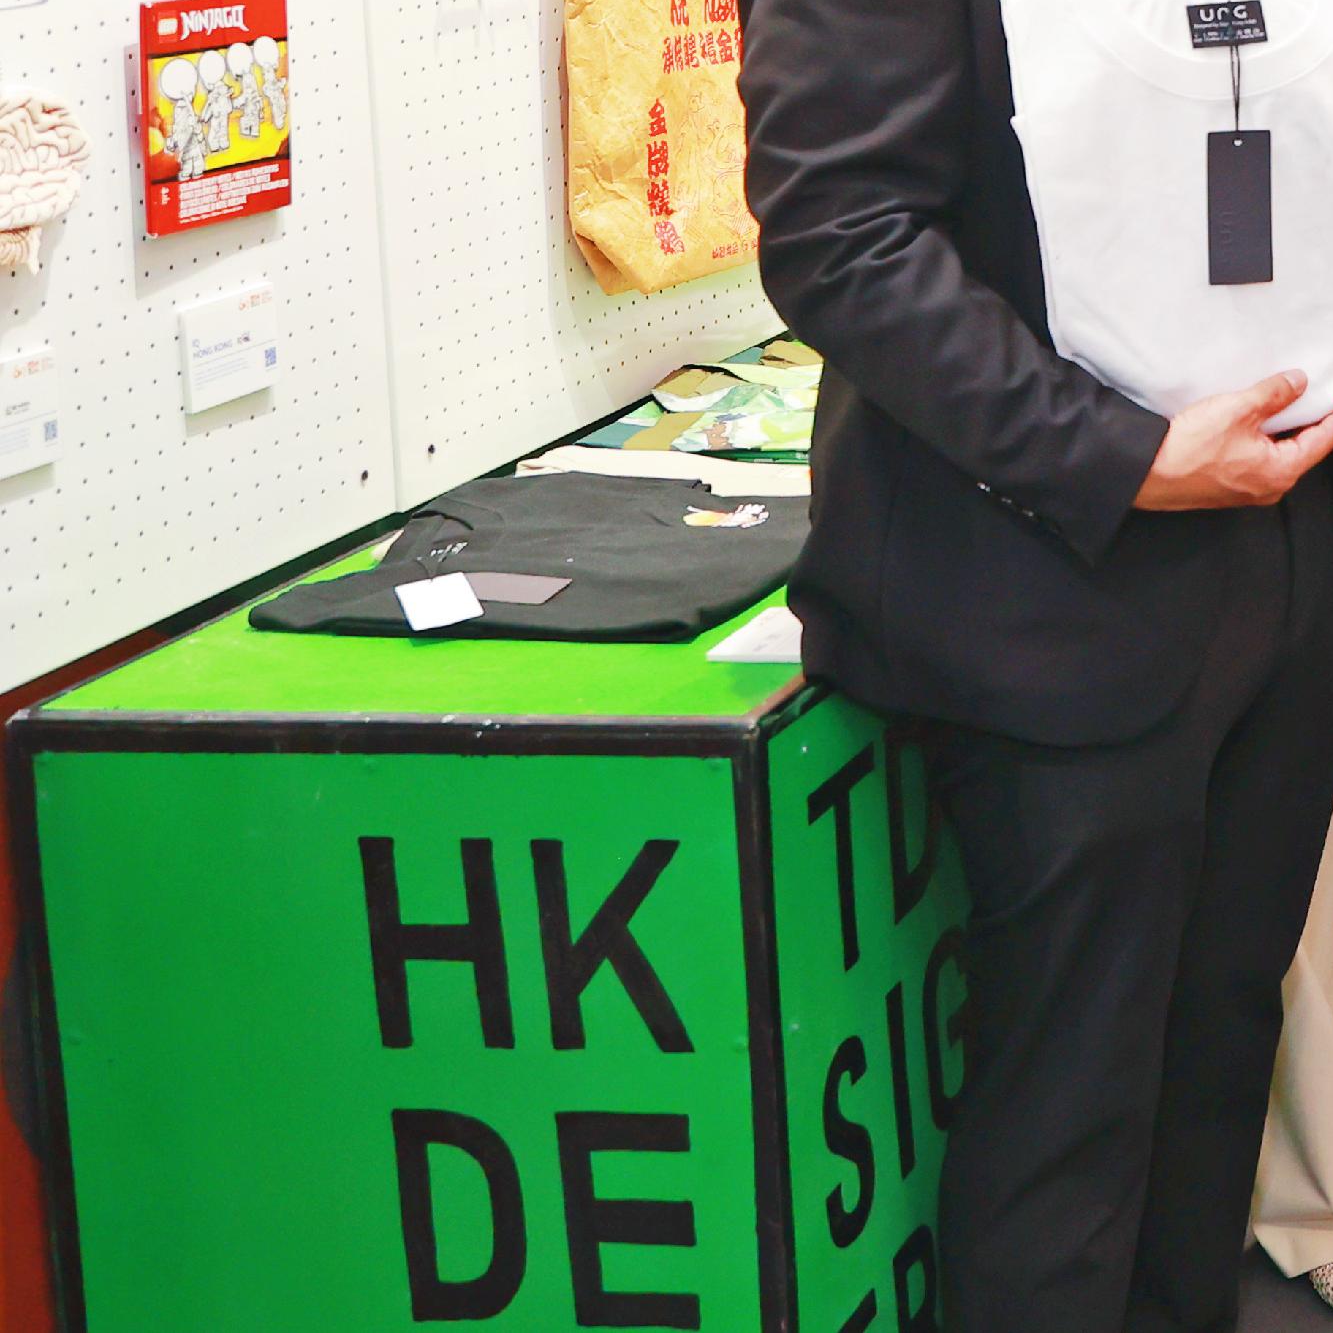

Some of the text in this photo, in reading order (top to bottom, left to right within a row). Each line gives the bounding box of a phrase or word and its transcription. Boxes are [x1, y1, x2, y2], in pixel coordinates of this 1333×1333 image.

[179, 4, 250, 41] NINJAGO
[356, 835, 696, 1054] HK
[390, 1108, 702, 1330] DE
